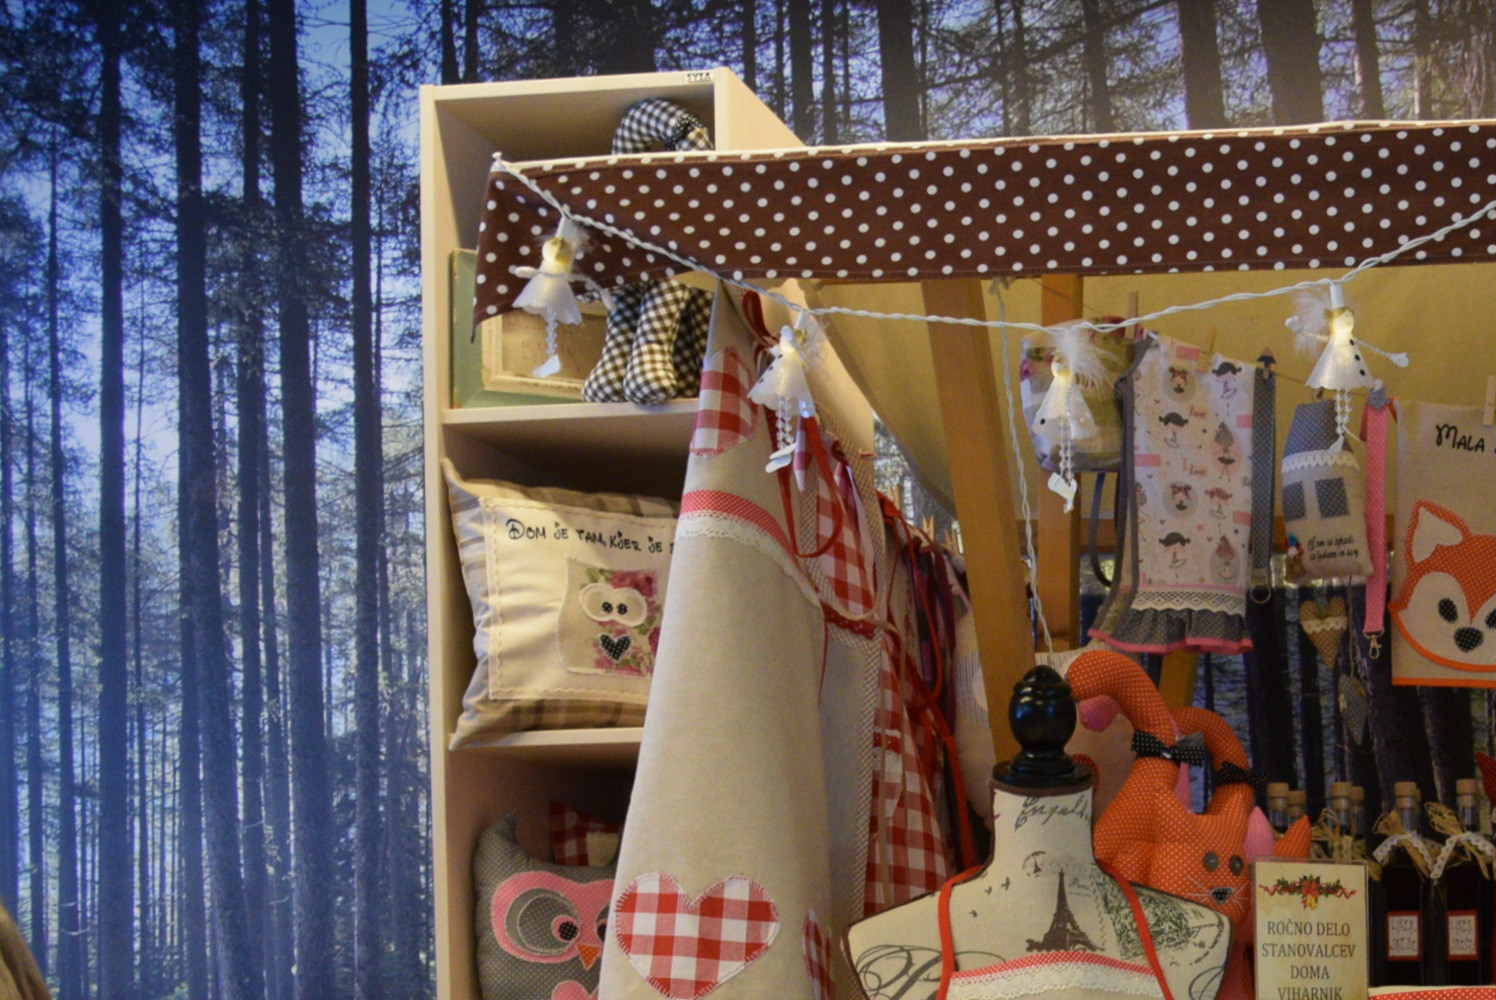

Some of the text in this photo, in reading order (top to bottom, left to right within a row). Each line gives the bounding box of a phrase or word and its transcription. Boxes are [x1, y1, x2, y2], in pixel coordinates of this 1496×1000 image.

[1267, 918, 1351, 937] ROČNO DELO
[1261, 943, 1356, 959] STANOVALCEV
[1290, 964, 1330, 980] DOMA
